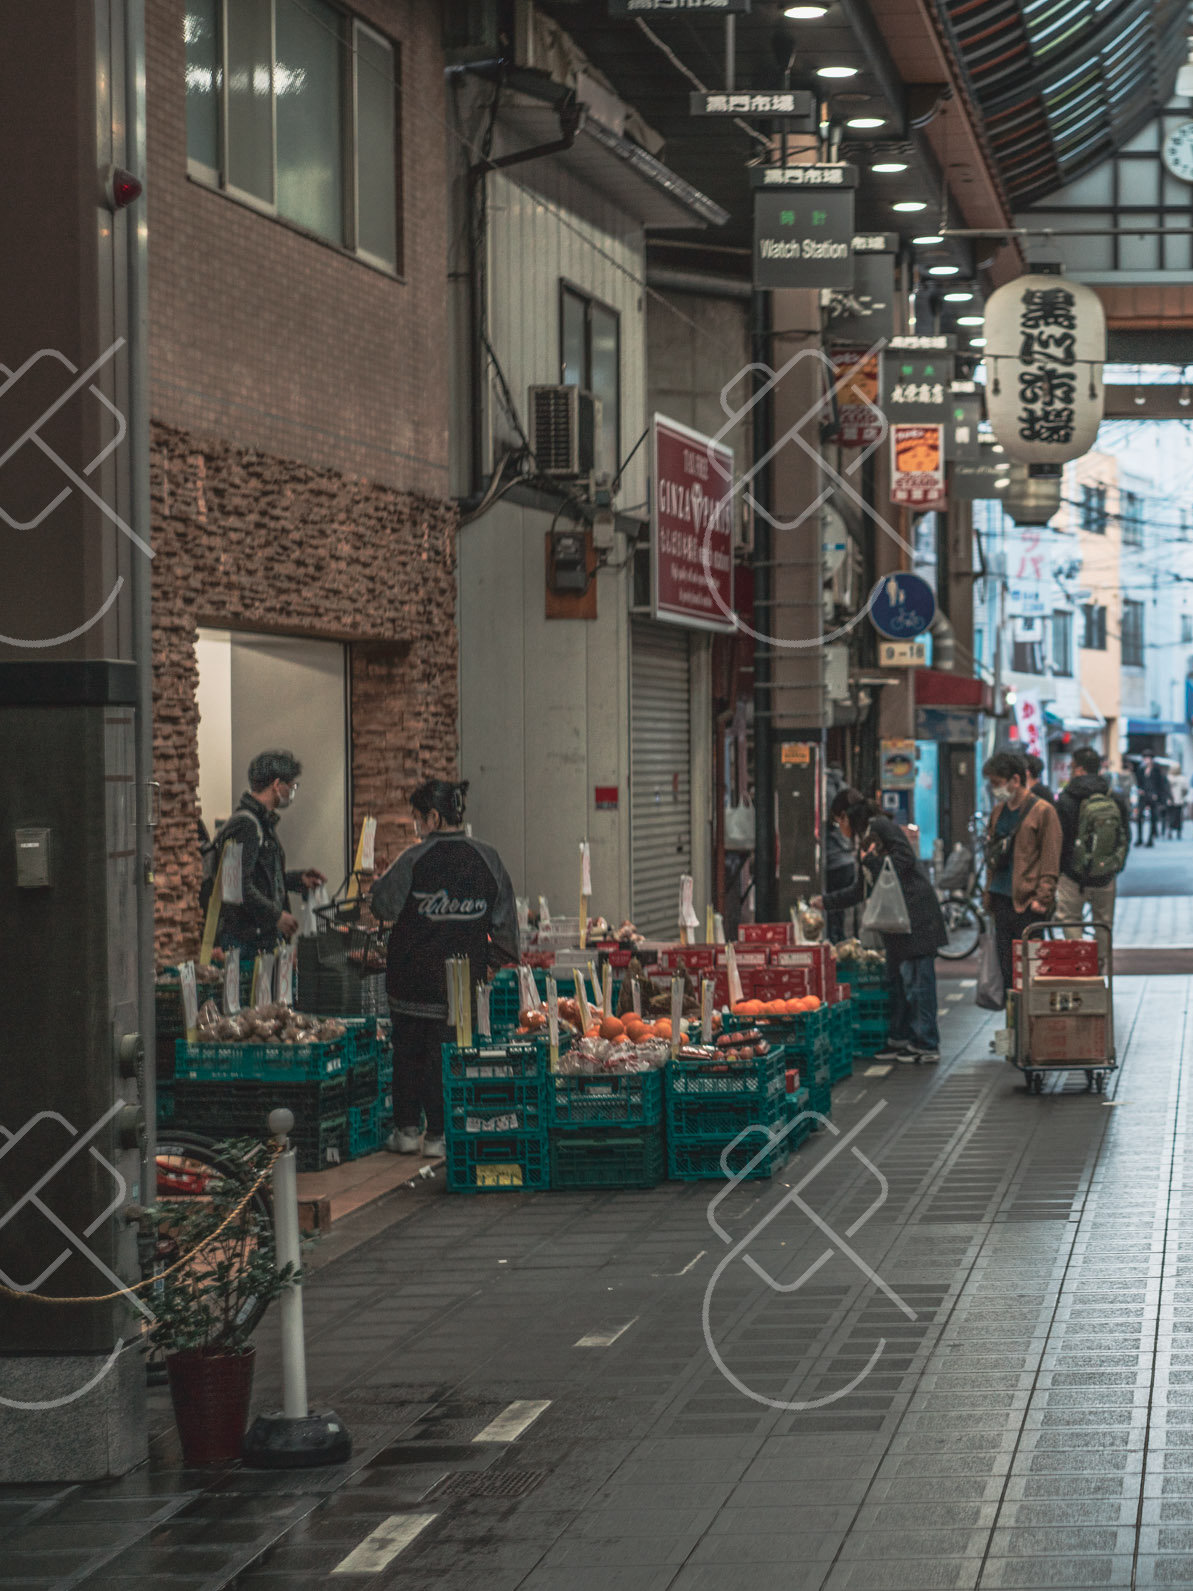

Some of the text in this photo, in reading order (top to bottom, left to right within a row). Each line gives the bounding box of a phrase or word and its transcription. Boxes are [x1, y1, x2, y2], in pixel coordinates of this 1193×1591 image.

[705, 95, 795, 112] 黒門市場
[763, 168, 844, 184] 黒門市場
[760, 238, 848, 259] Watch Station
[658, 479, 691, 523] GINZA
